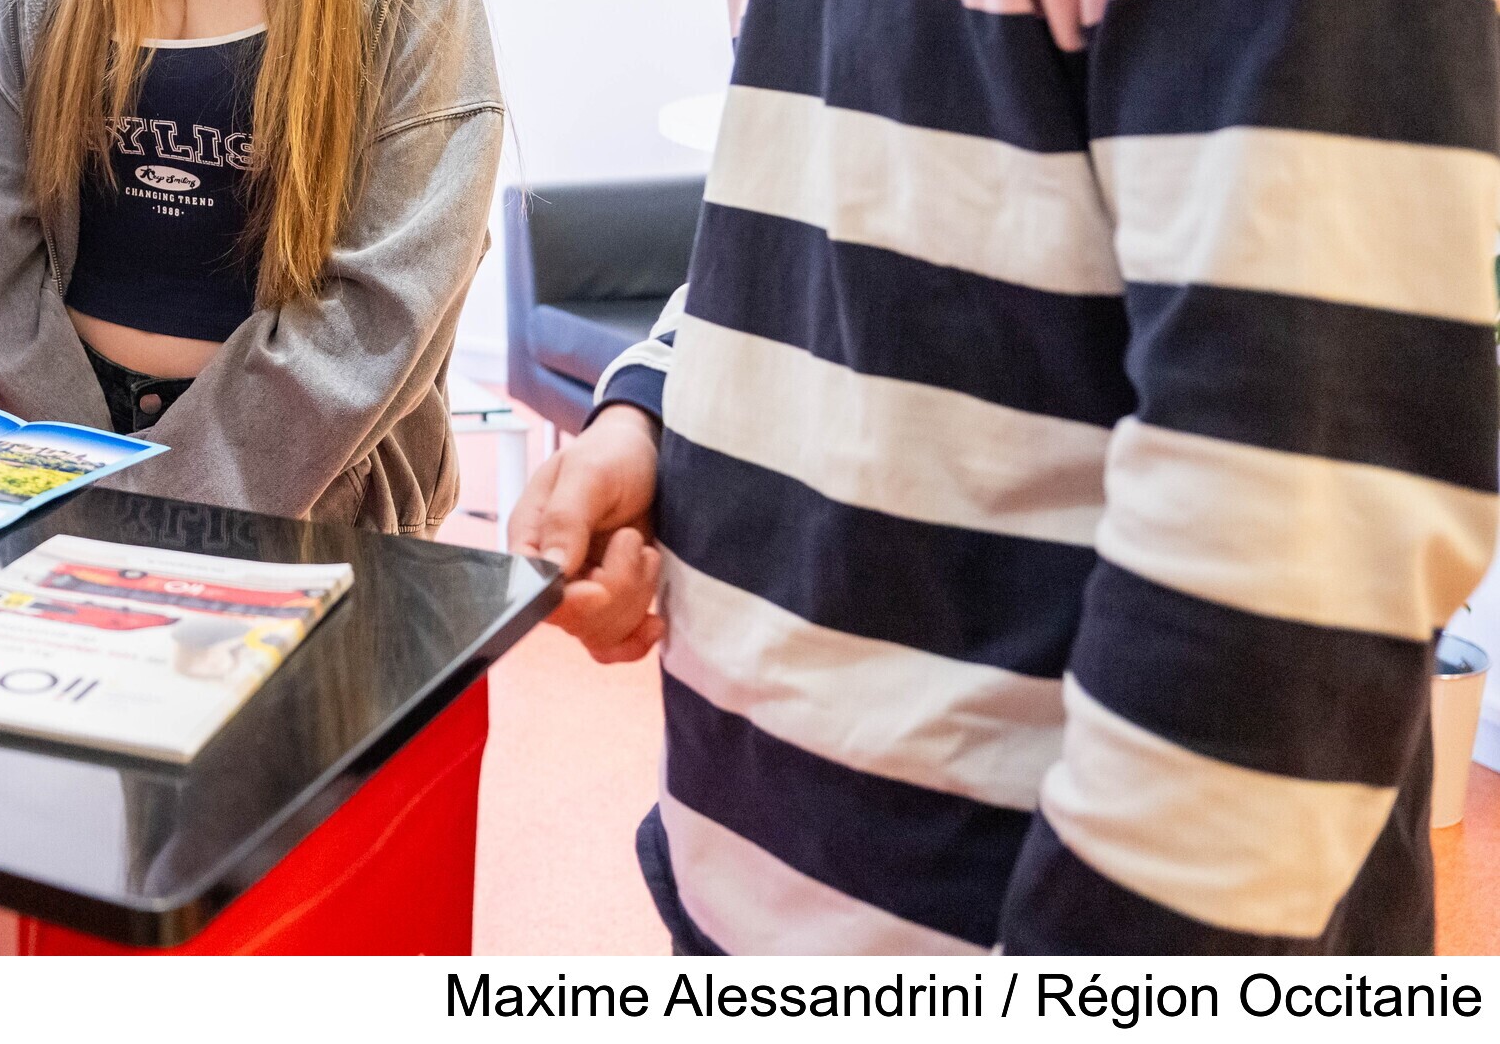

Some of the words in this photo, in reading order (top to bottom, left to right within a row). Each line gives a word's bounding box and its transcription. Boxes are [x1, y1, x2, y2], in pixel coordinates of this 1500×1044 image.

[102, 116, 267, 170] YLIS
[166, 175, 196, 189] Smiling
[125, 187, 175, 202] CHANGING
[178, 195, 214, 207] TREND
